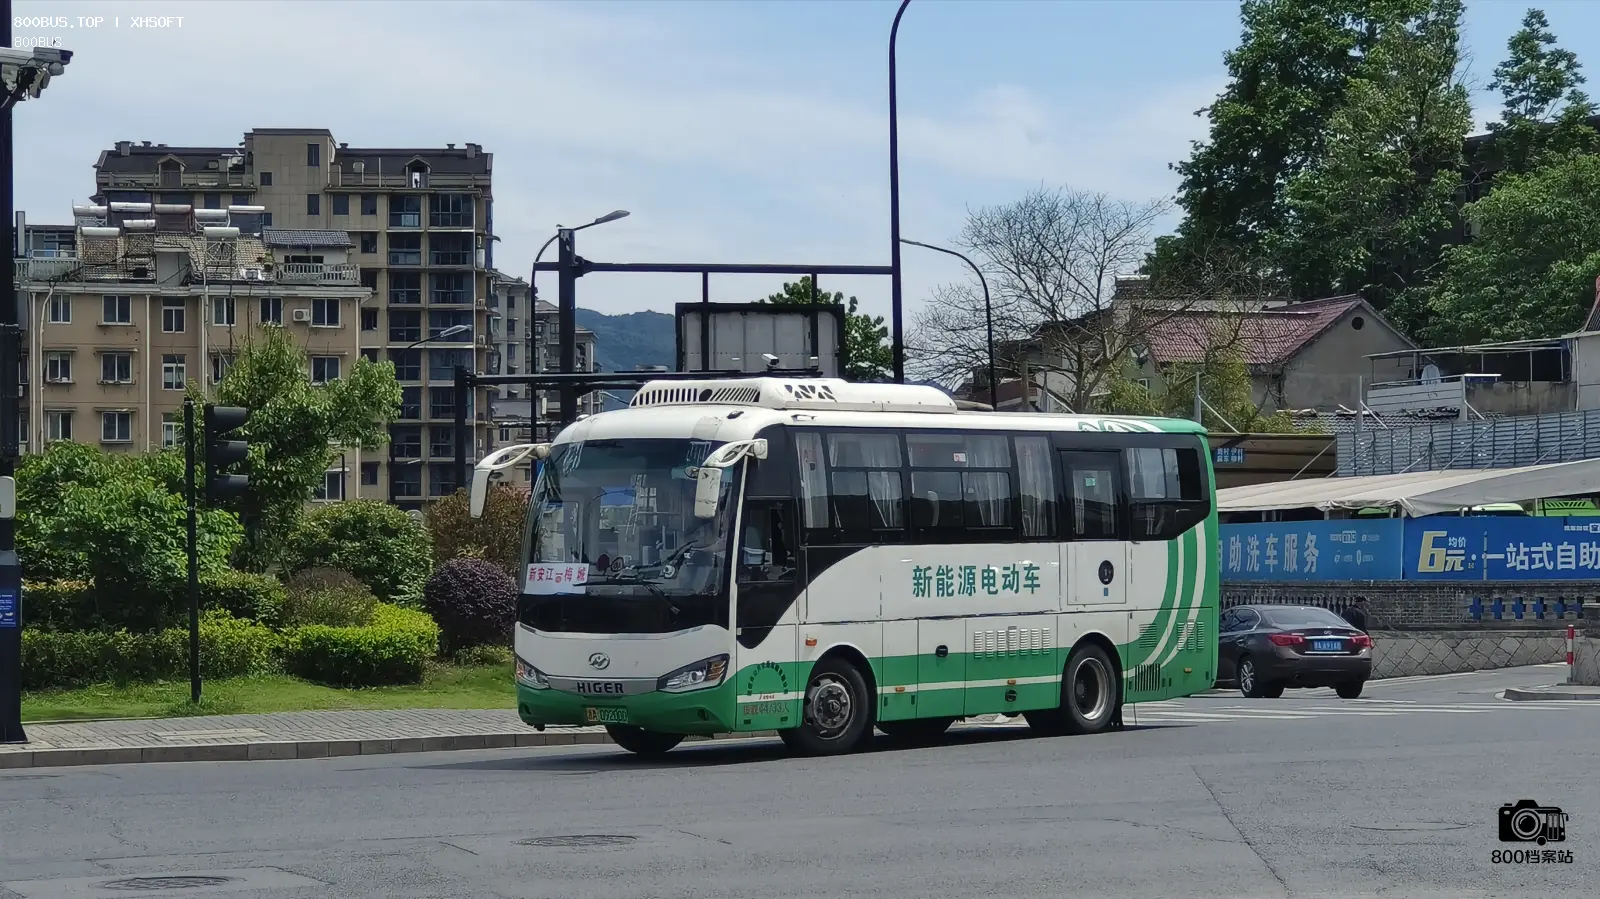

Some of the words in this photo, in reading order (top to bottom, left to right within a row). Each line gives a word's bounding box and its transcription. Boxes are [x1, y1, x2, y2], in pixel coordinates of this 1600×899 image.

[1448, 536, 1467, 548] 均价
[912, 563, 1041, 598] 新能源电动车
[576, 681, 624, 694] HIGER
